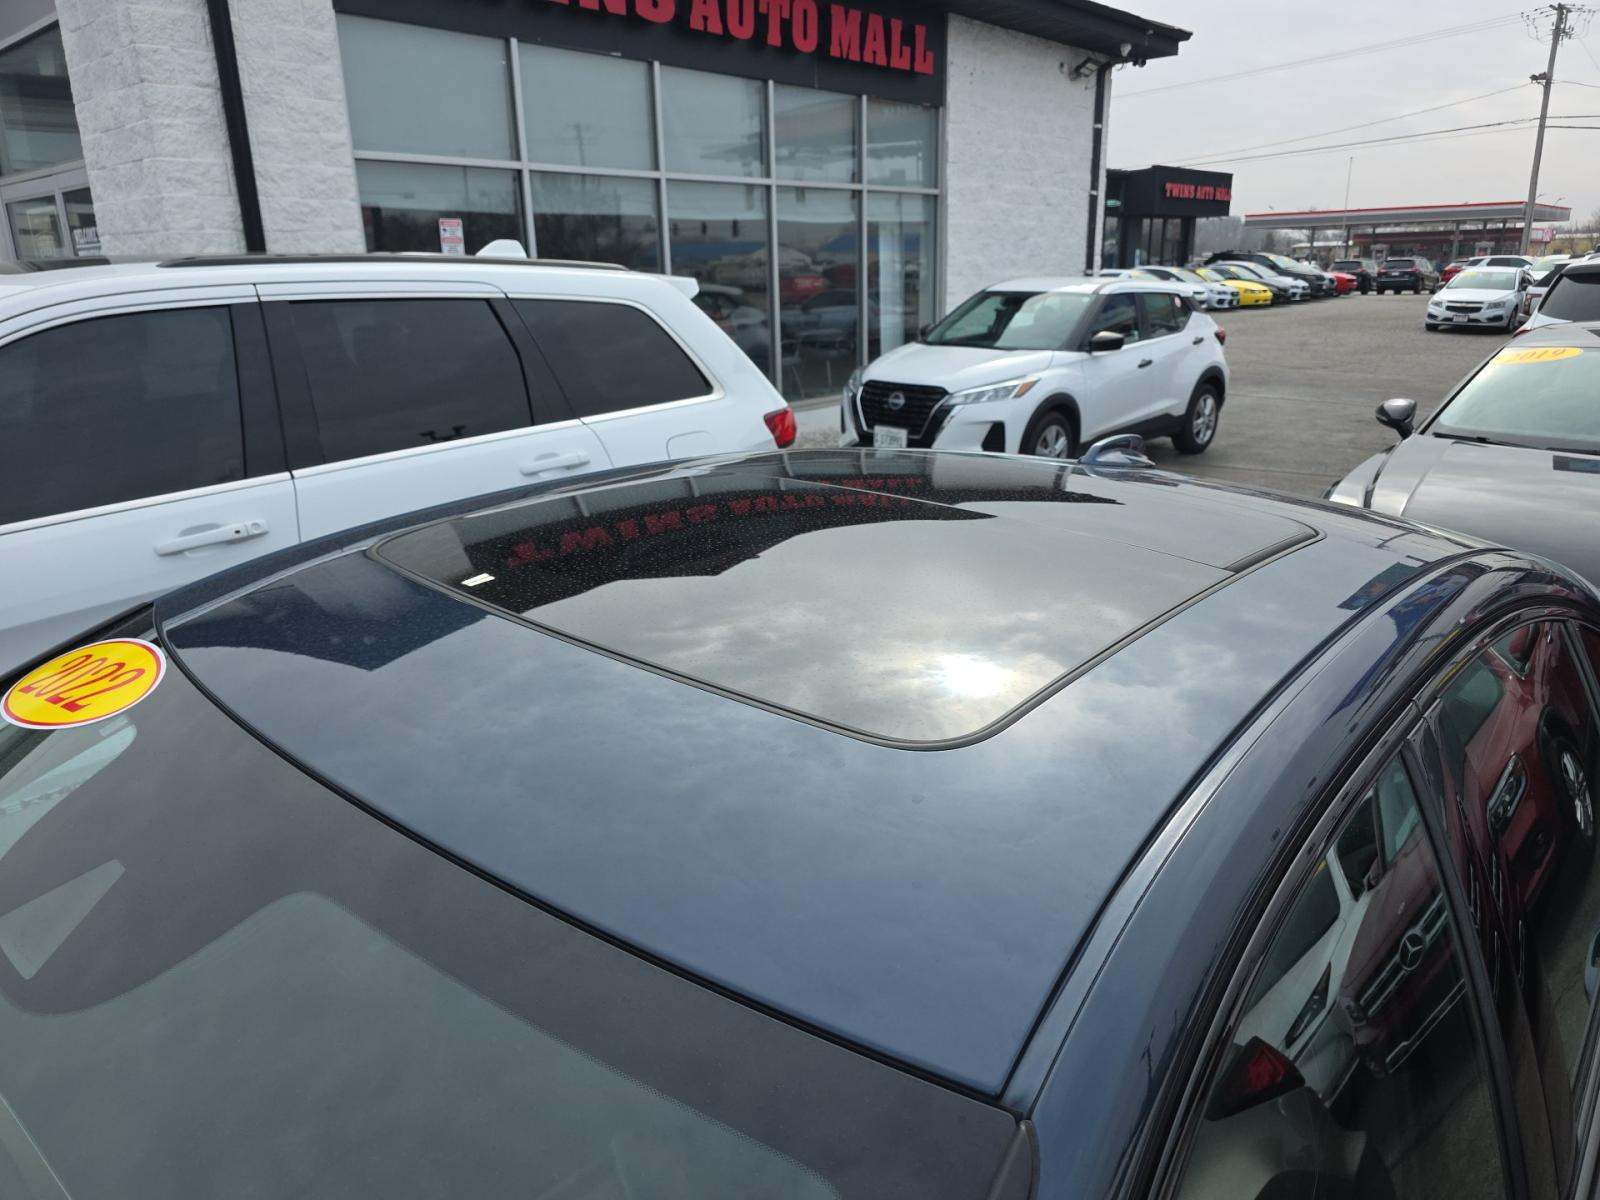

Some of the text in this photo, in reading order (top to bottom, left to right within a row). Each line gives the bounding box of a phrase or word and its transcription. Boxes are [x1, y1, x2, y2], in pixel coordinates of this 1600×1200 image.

[689, 0, 934, 75] AUTO MALL
[1165, 182, 1196, 199] TWINS
[18, 653, 146, 713] 2022
